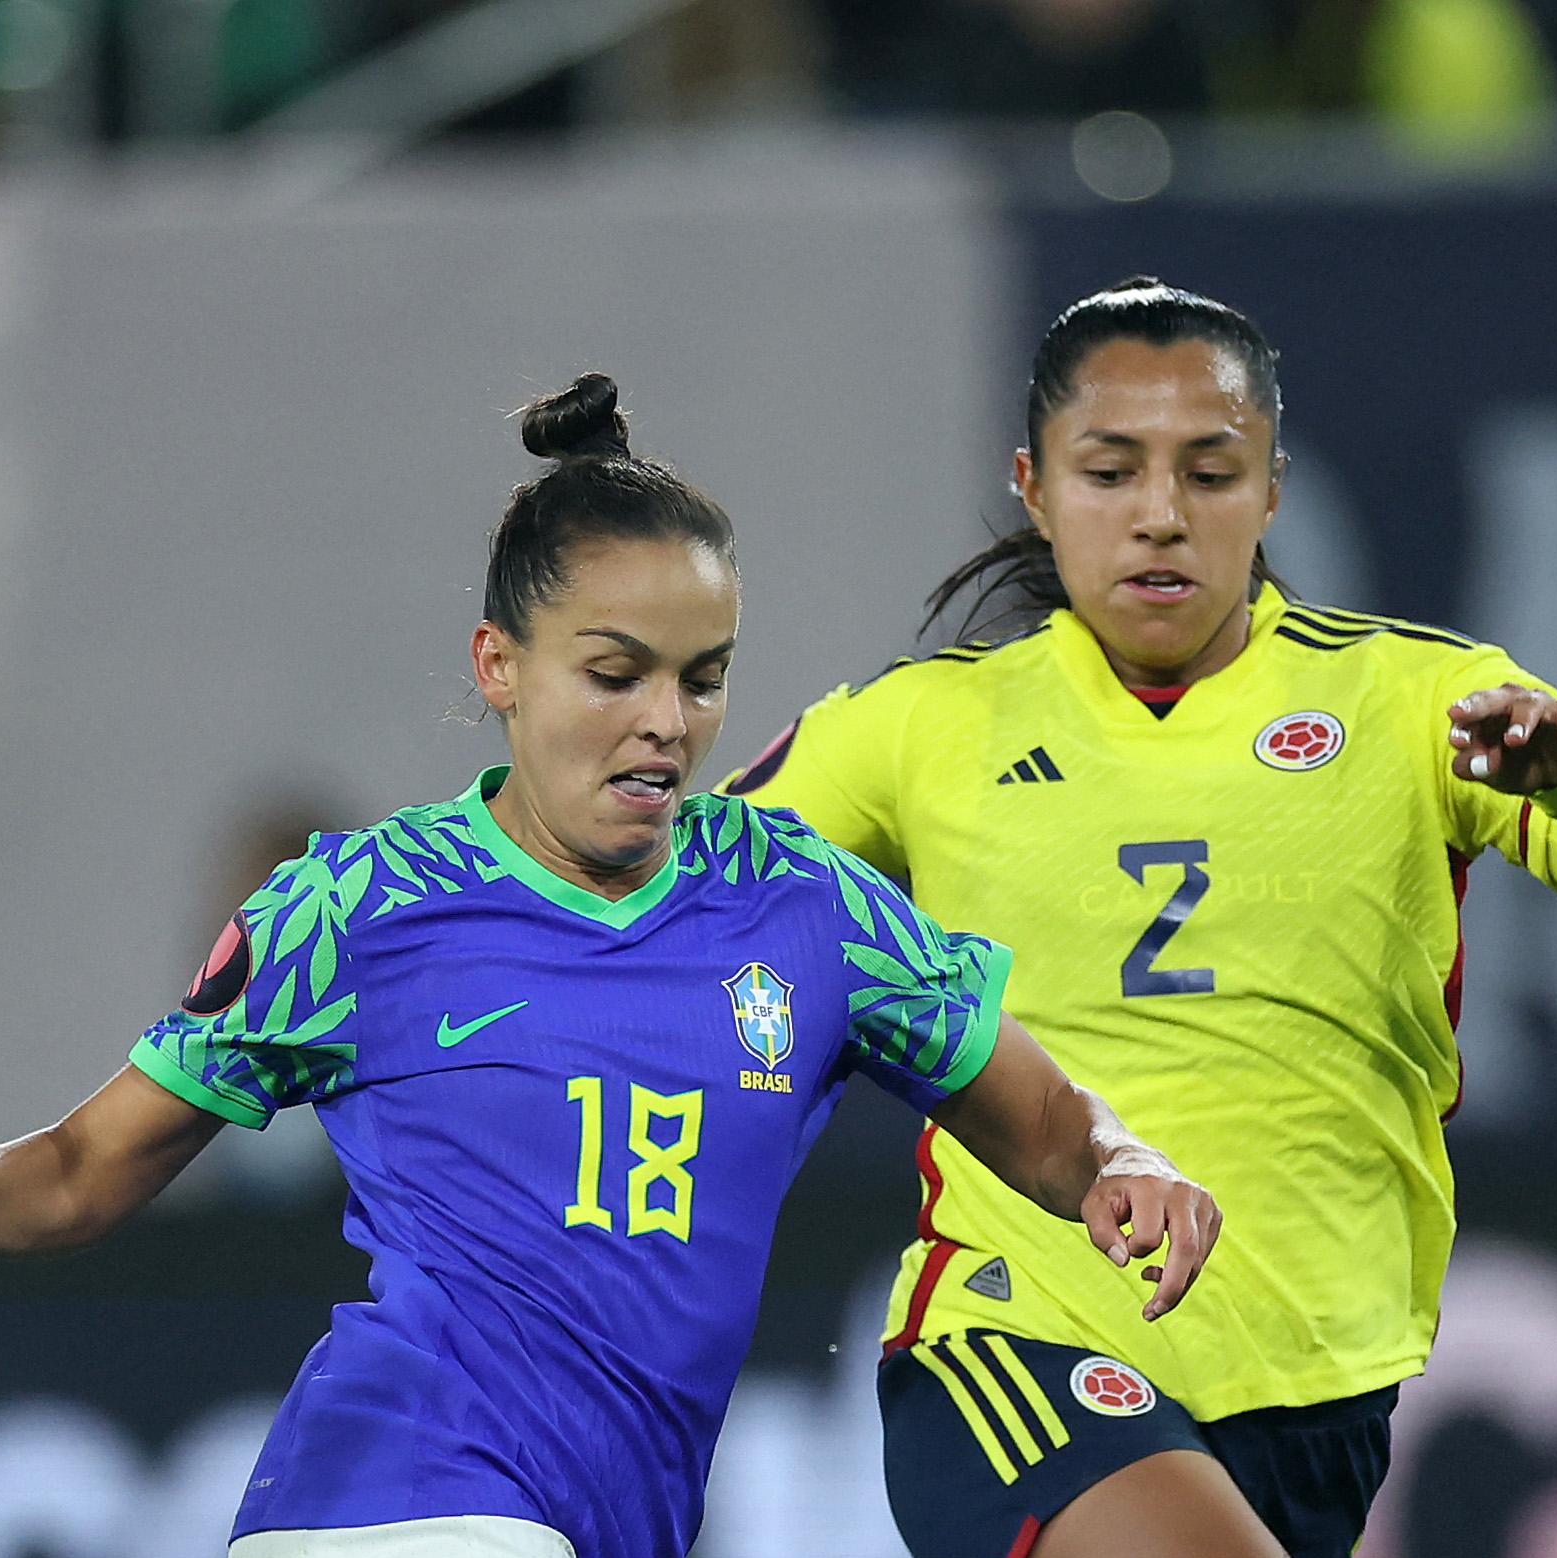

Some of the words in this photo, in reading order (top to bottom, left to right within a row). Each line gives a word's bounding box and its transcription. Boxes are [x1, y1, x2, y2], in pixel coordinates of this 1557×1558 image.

[1118, 839, 1214, 997] 2
[752, 1004, 775, 1019] CBF
[739, 1070, 794, 1094] BRASIL
[564, 1075, 705, 1245] 18
